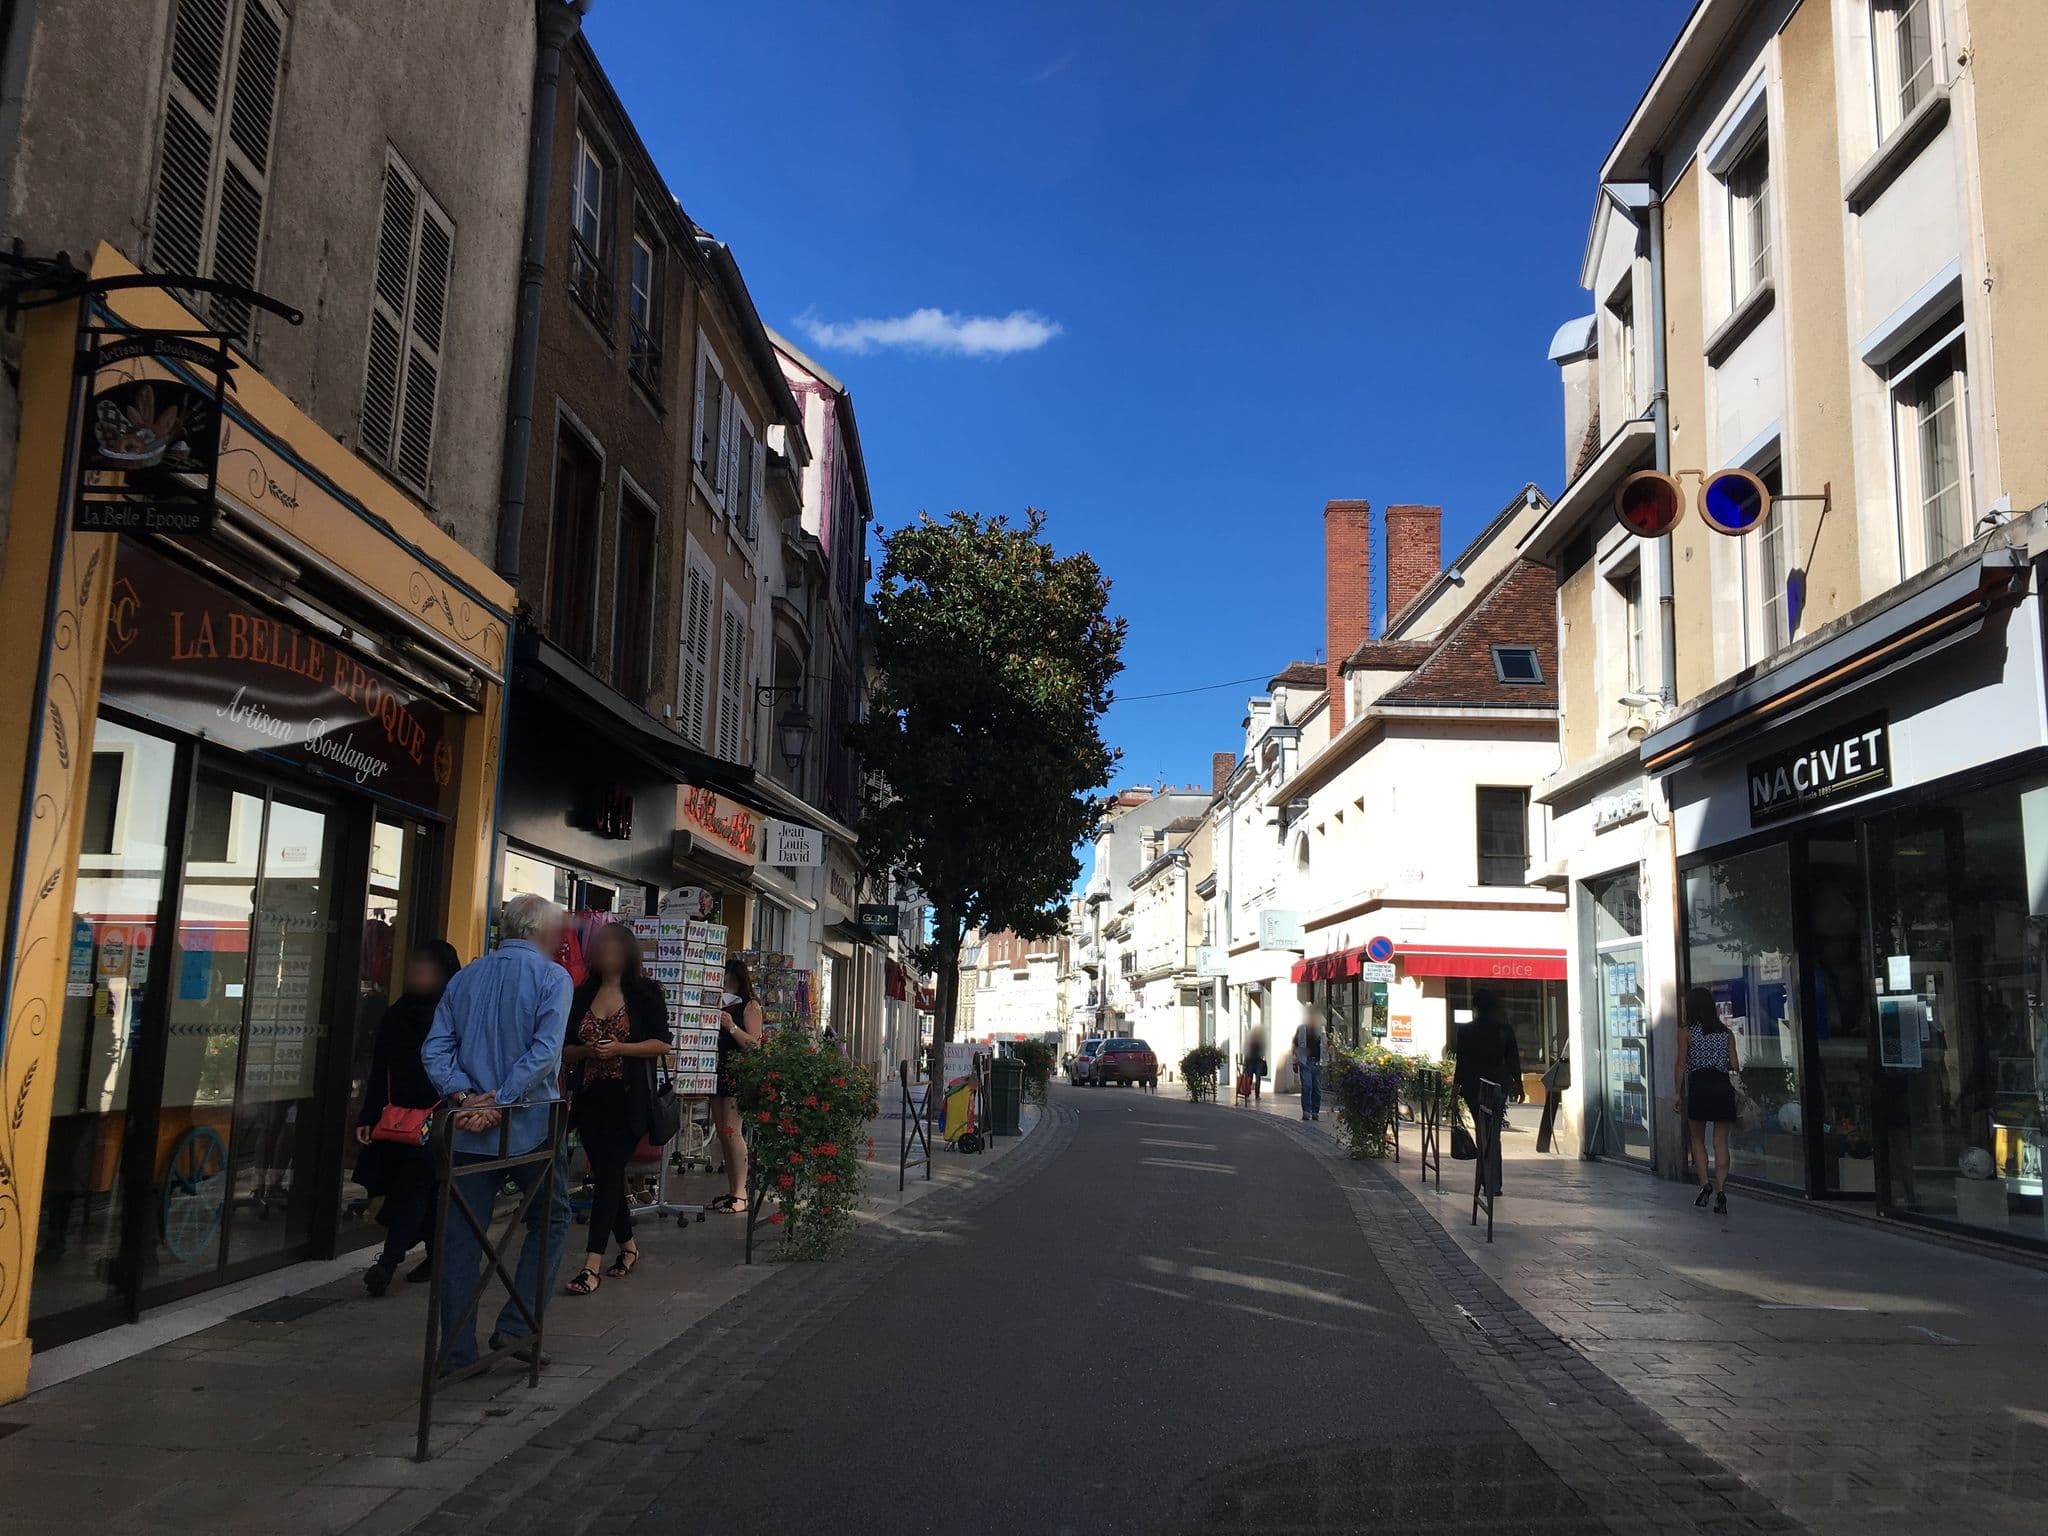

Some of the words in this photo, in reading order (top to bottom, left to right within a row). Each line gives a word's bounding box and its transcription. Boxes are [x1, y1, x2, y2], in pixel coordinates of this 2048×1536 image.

[100, 344, 145, 365] Artisan
[83, 506, 100, 526] La
[104, 505, 140, 526] Belle
[170, 610, 218, 660] LA
[227, 613, 325, 683] BELLE
[331, 650, 425, 766] EPOQUE
[216, 686, 294, 743] Artisan
[304, 717, 388, 784] Boulanger
[778, 825, 805, 838] Jean
[779, 837, 810, 850] Louis
[778, 850, 810, 863] David
[688, 925, 706, 935] 1960
[660, 945, 682, 956] 1946
[687, 949, 703, 959] 1962
[658, 967, 680, 977] 1949
[681, 1032, 698, 1045] 1970
[701, 1035, 716, 1046] 1971
